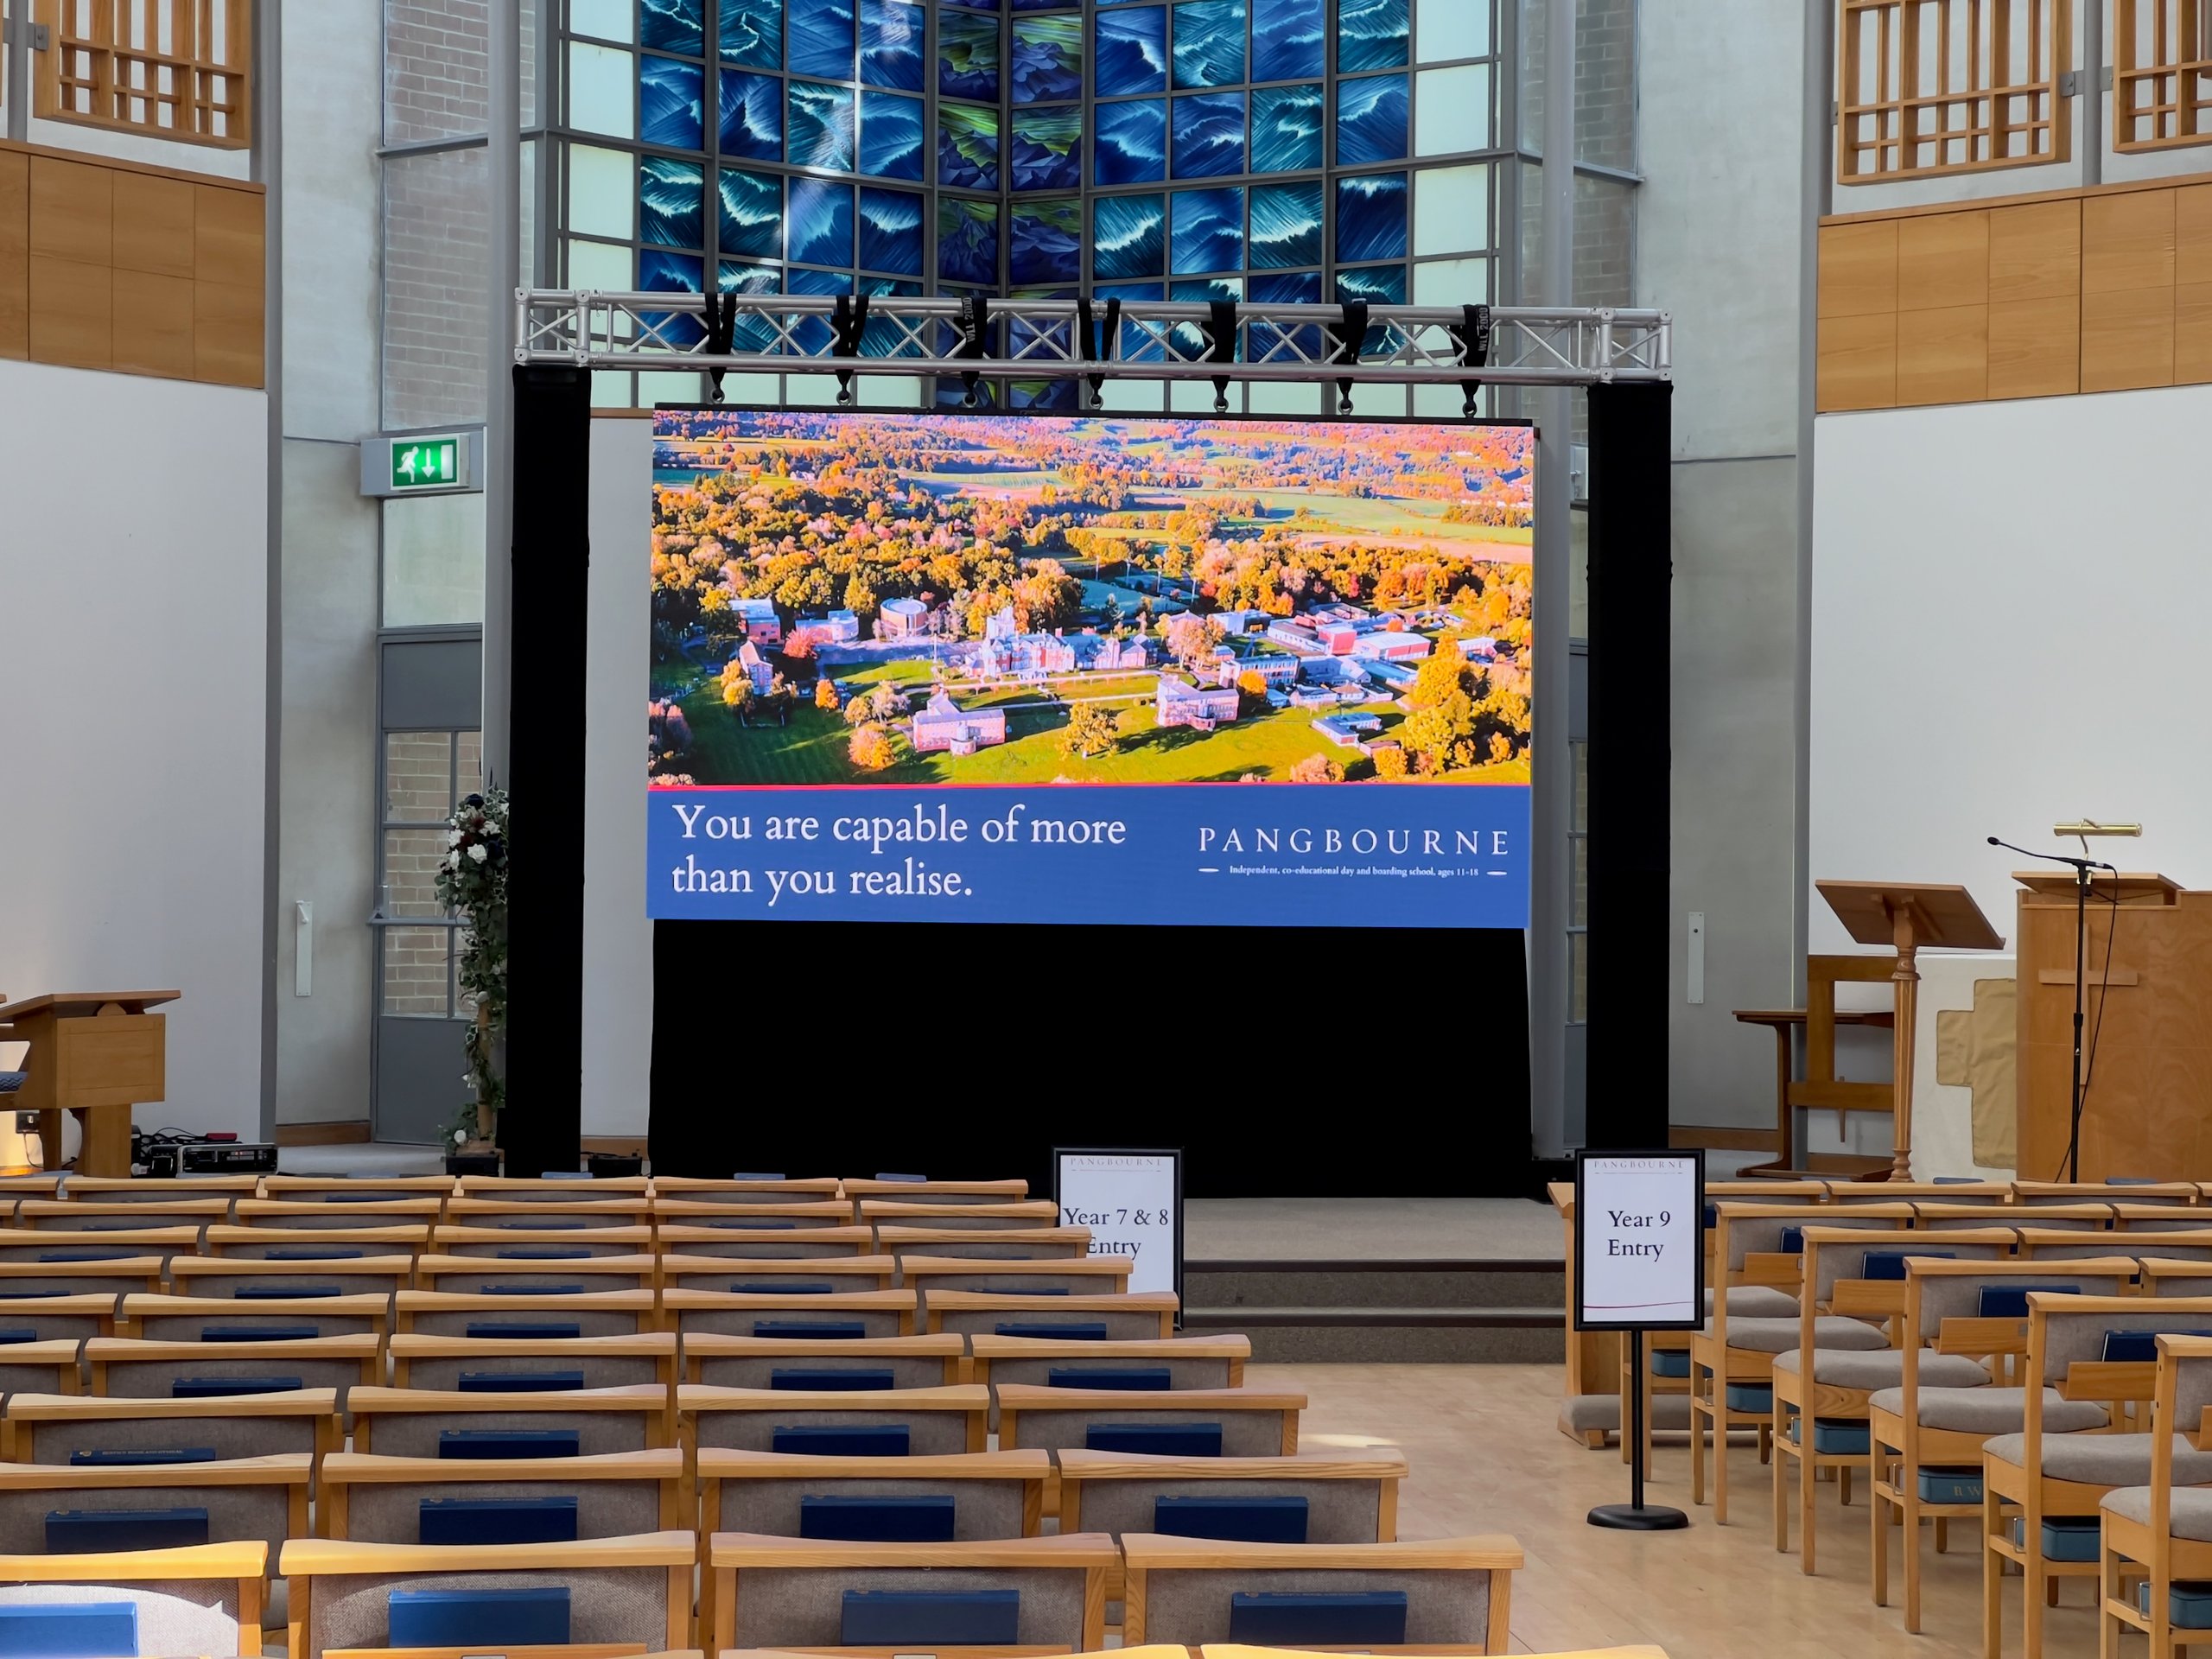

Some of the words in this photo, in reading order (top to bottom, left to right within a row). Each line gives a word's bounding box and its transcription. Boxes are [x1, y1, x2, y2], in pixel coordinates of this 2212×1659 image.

[963, 296, 974, 321] 2000
[1478, 307, 1488, 330] 2000
[965, 322, 976, 343] WLL
[1478, 333, 1488, 352] WLL
[672, 804, 752, 841] You
[765, 813, 820, 842] are
[831, 804, 968, 854] capable
[981, 804, 1025, 843] of
[1031, 817, 1127, 844] more
[1198, 827, 1509, 855] PANGBOURNE
[672, 855, 753, 893] than
[765, 867, 836, 907] you
[849, 857, 973, 897] realise.
[1230, 864, 1281, 876] Independent,
[1281, 865, 1339, 875] co-educational
[1340, 866, 1355, 877] day
[1356, 867, 1371, 875] and
[1372, 867, 1408, 878] boarding
[1408, 867, 1436, 877] school,
[1437, 869, 1455, 878] ages
[1063, 1208, 1110, 1225] Year
[1116, 1209, 1128, 1225] 7
[1134, 1209, 1151, 1225] &
[1159, 1209, 1169, 1225] 8
[1607, 1211, 1654, 1228] Year
[1660, 1211, 1671, 1227] 9
[1607, 1239, 1664, 1262] Entry
